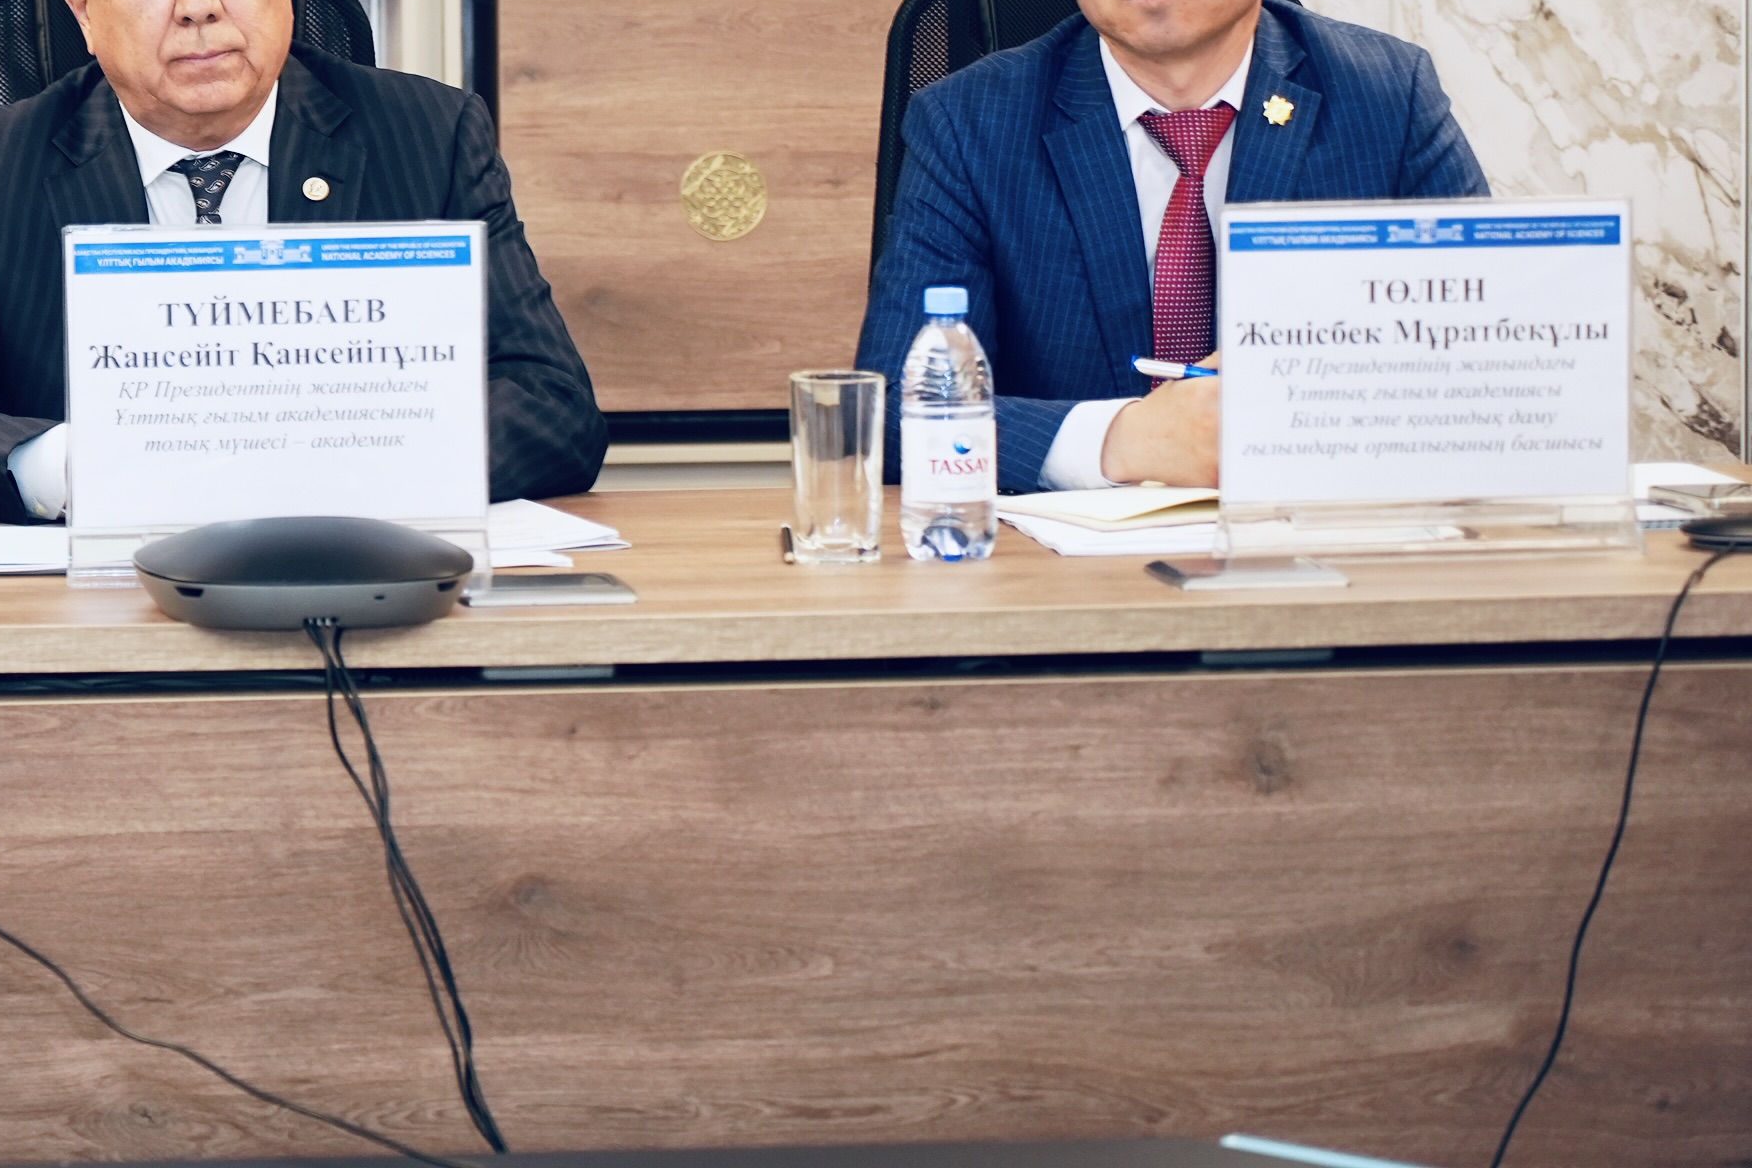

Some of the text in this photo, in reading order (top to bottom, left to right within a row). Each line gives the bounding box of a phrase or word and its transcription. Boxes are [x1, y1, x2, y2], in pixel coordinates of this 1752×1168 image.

[1361, 278, 1484, 304] ТӨЛЕН
[158, 295, 387, 328] ТҮЙМЕБАЕВ
[1236, 318, 1609, 350] Жеңісбек Мұратбекұлы
[89, 338, 456, 370] Жансейіт Қансейітұлы
[118, 381, 148, 400] ҚР
[153, 379, 302, 402] Президентінің
[275, 404, 435, 424] академиясының
[144, 439, 210, 455] толық
[215, 433, 288, 455] мүшесі
[310, 431, 406, 449] академик
[929, 458, 988, 476] TASSAY
